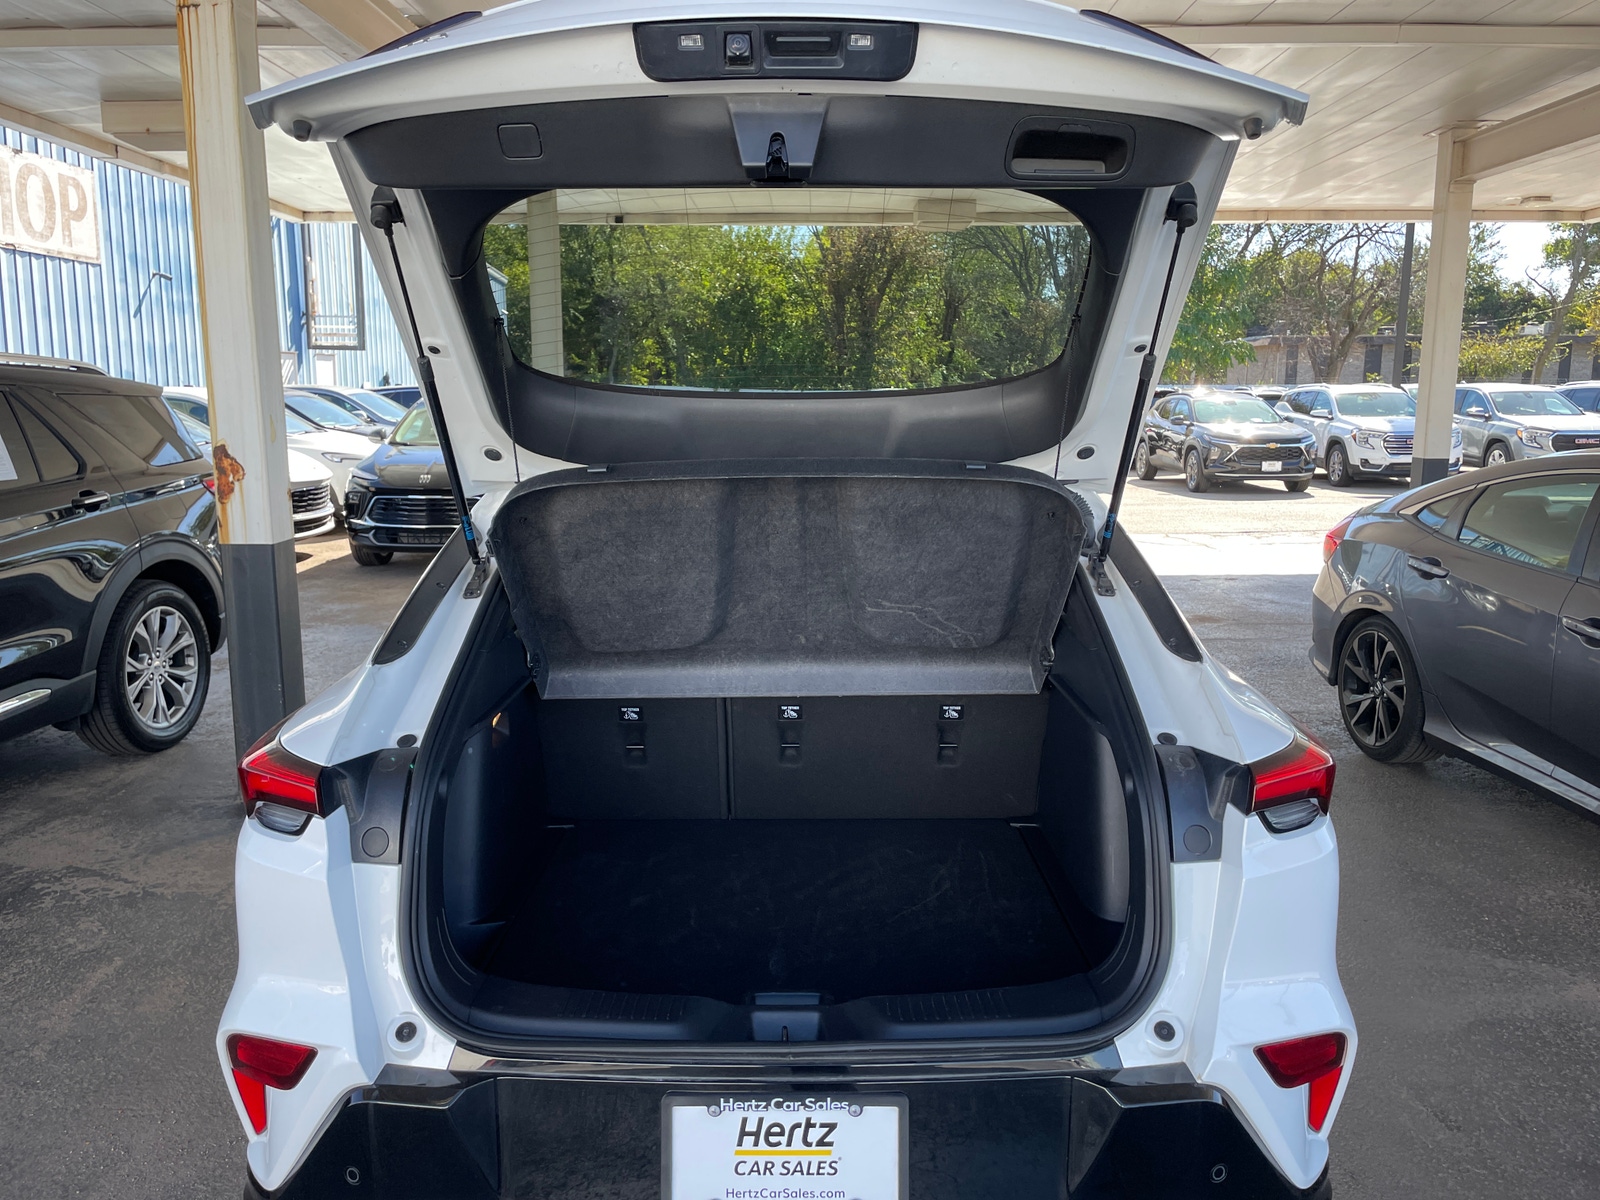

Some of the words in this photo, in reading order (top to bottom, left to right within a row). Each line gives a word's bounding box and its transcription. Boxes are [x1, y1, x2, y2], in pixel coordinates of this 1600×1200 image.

[720, 1097, 768, 1112] Hertz
[770, 1097, 801, 1112] Car
[804, 1097, 849, 1112] Sales
[736, 1116, 839, 1148] Hertz
[734, 1160, 775, 1176] CAR
[779, 1160, 839, 1176] SALES
[725, 1187, 846, 1200] HertzCarSales.com
